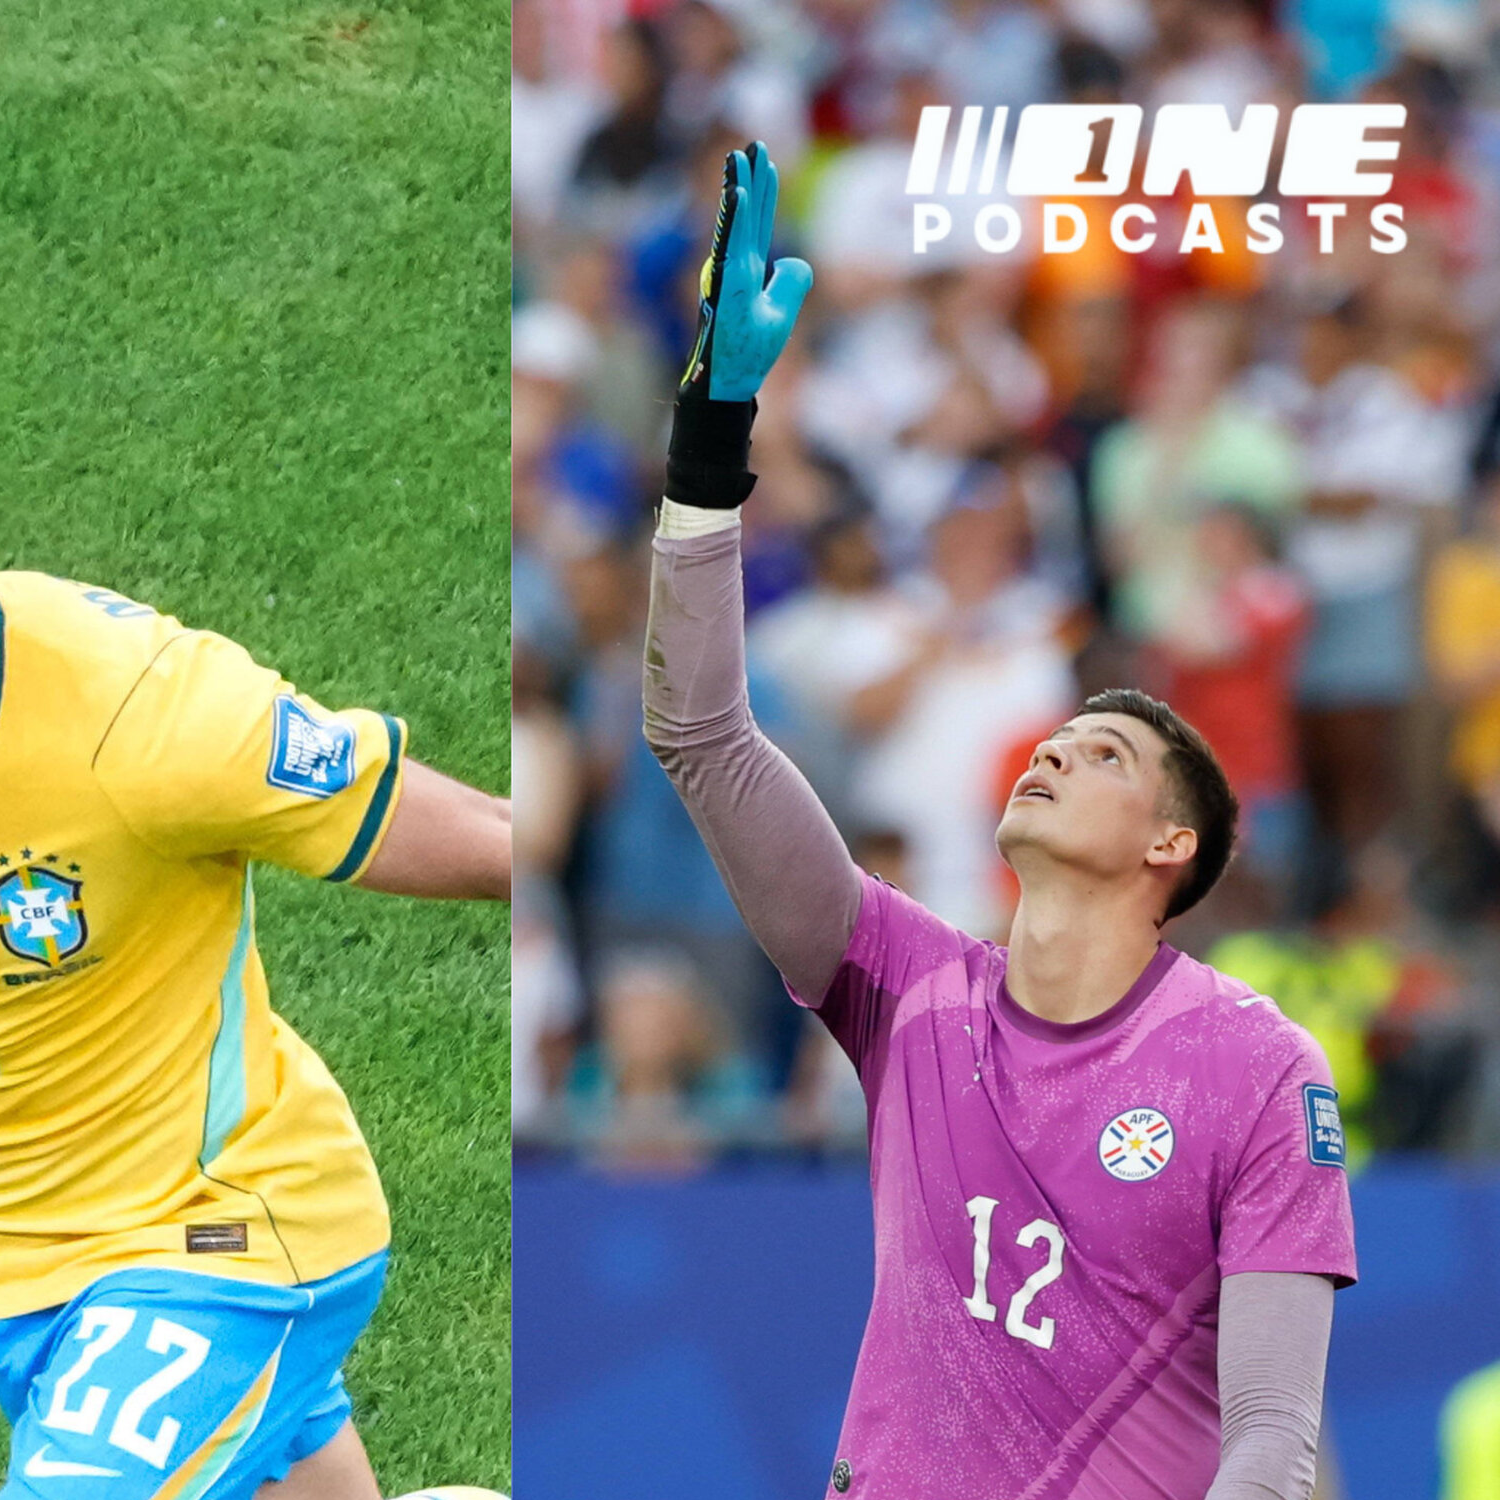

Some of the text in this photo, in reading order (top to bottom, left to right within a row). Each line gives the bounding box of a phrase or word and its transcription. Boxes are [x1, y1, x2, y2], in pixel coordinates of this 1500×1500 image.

[20, 905, 56, 920] CBF
[1129, 1113, 1155, 1125] APF
[961, 1195, 1066, 1351] 12
[39, 1305, 212, 1471] 22
